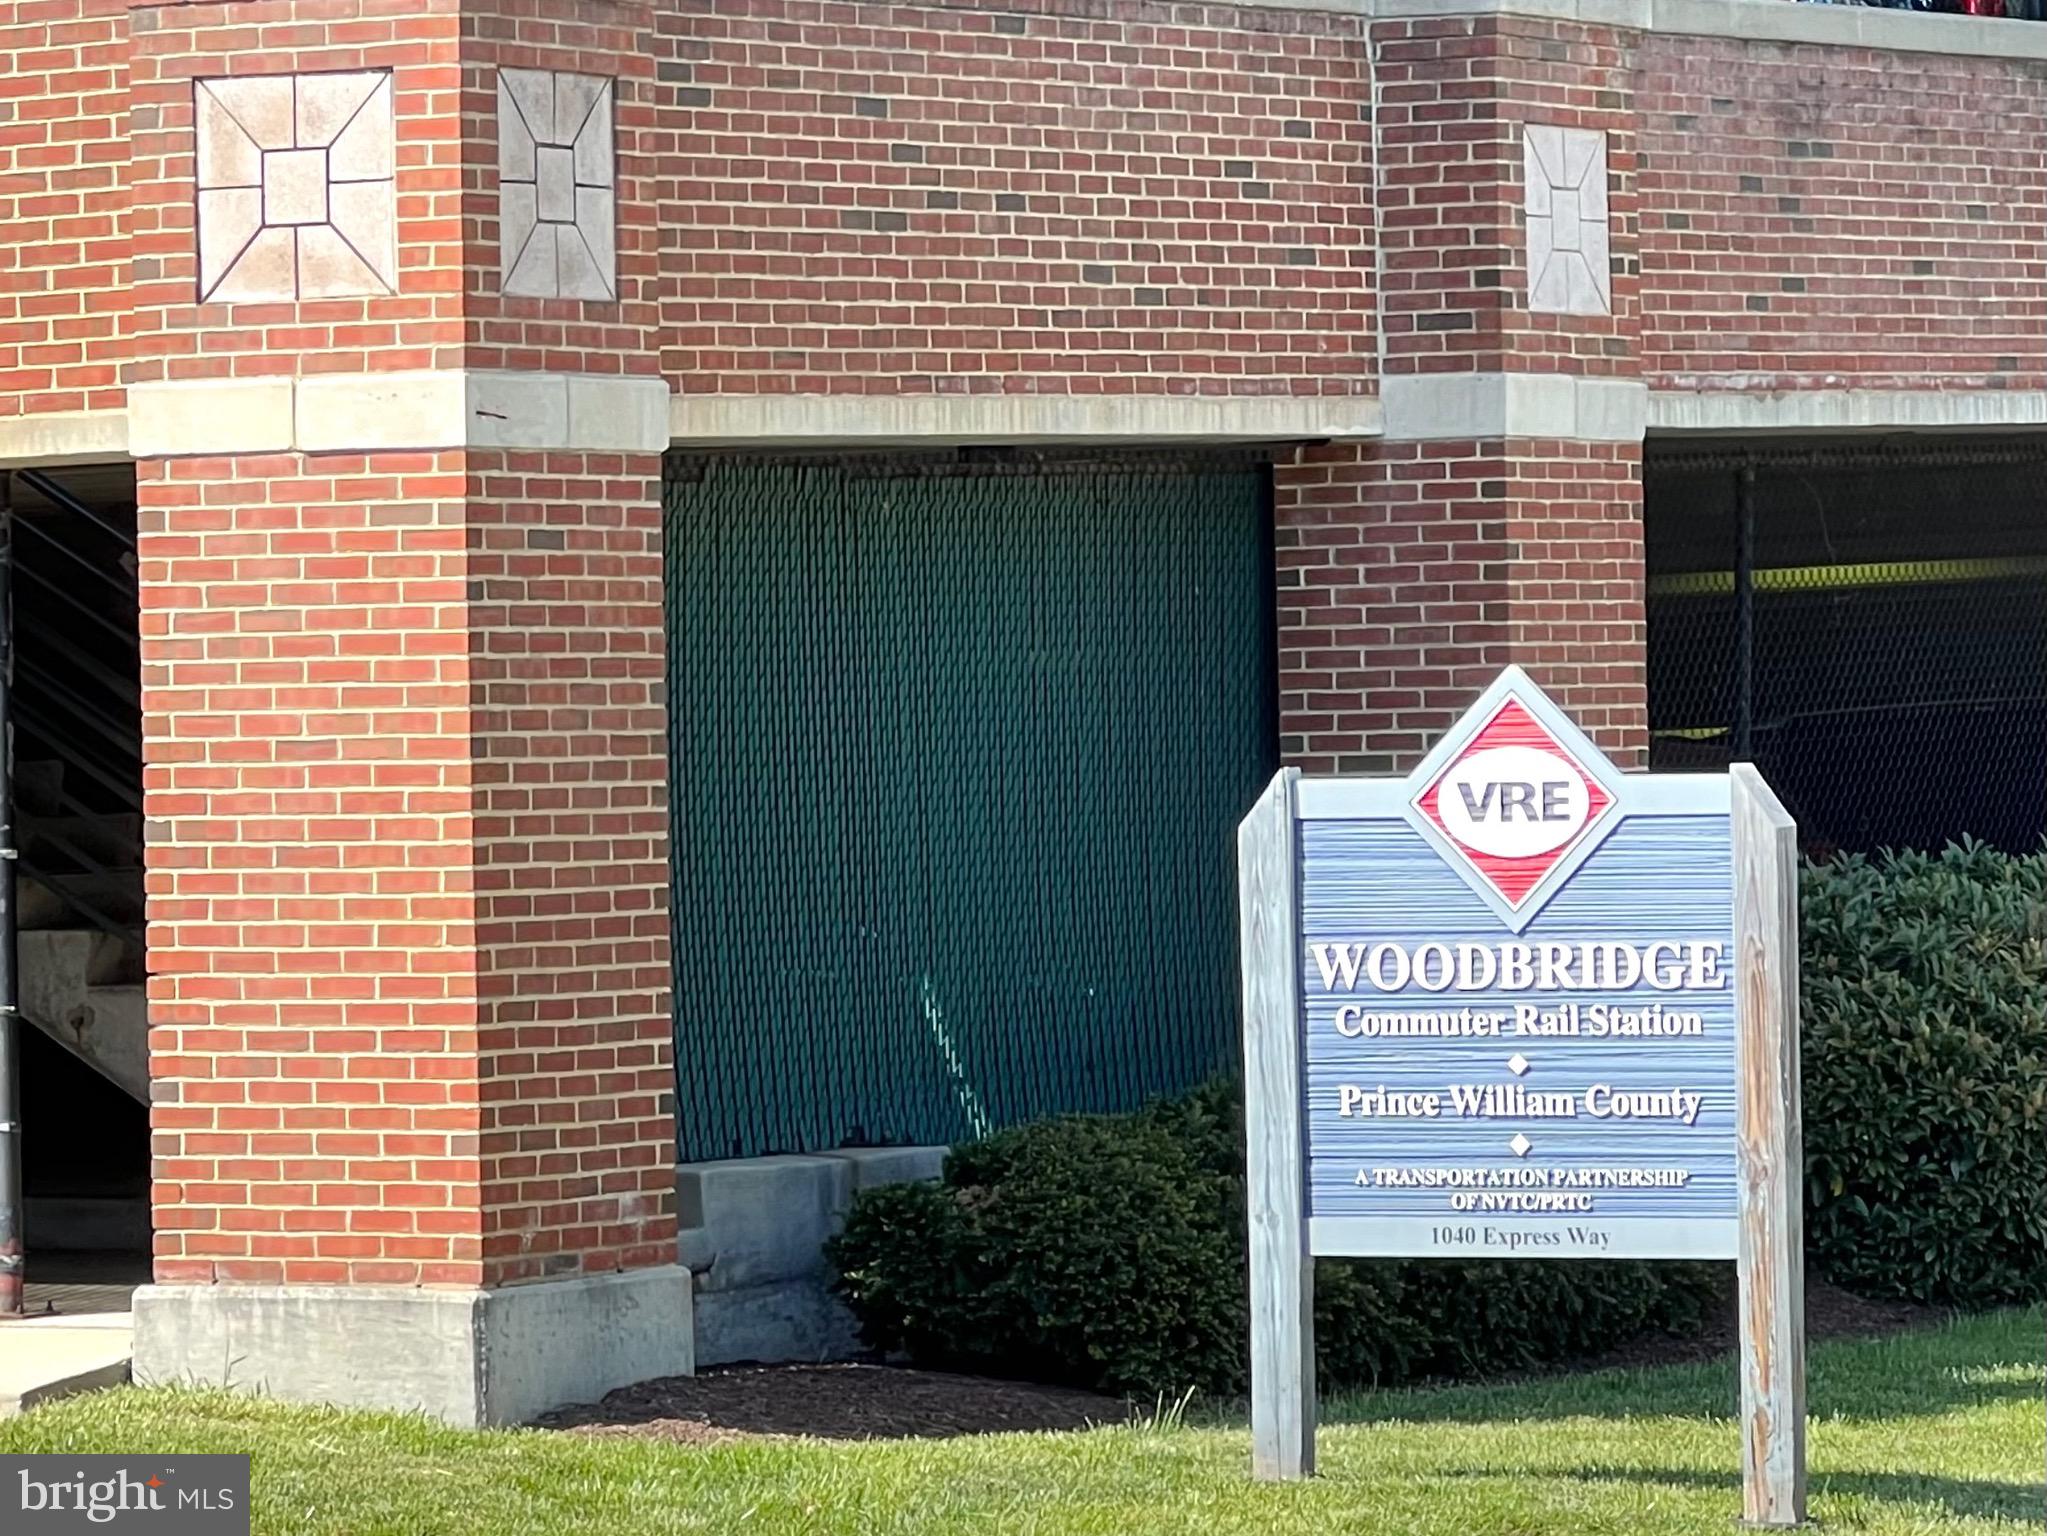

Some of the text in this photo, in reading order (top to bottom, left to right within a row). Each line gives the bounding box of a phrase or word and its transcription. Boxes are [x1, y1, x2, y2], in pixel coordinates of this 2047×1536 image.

[1458, 781, 1571, 823] VRE
[1311, 940, 1726, 992] WOODBRIDGE
[1335, 1004, 1703, 1037] Commuter Rail Station
[1337, 1084, 1703, 1124] Prince William County
[1355, 1169, 1689, 1187] A TRANSPORTATION PARTNERSHIP
[1451, 1192, 1592, 1211] OF NVTC/PRTC
[1432, 1227, 1611, 1249] 1040 Express Way
